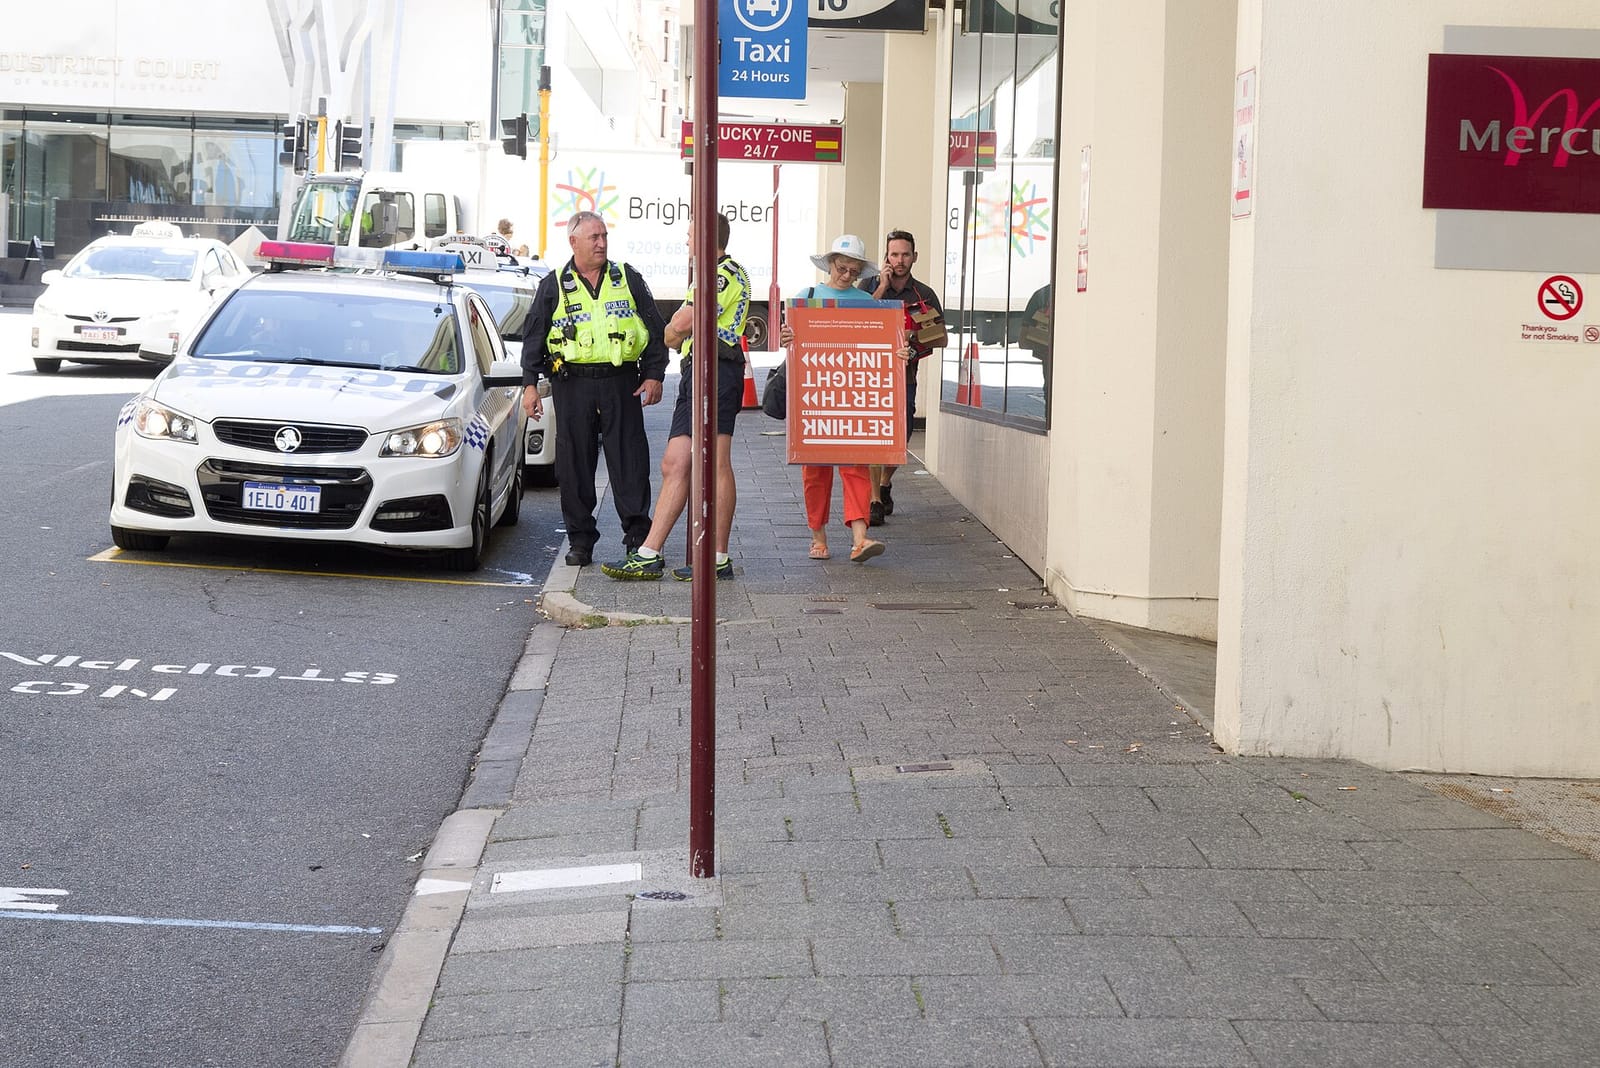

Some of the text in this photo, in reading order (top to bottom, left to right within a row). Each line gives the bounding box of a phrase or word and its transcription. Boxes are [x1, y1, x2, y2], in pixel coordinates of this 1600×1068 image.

[733, 37, 790, 63] Taxi
[0, 53, 222, 80] DISTRICT COURT
[731, 70, 790, 83] 24 Hours
[717, 127, 812, 143] UCKY 7-ONE
[743, 144, 779, 158] 24/7
[605, 300, 629, 310] POLICE
[1521, 324, 1558, 333] Thankyou
[1547, 333, 1579, 343] Smoking
[846, 352, 893, 369] LINK
[802, 371, 894, 389] FREIGHT
[821, 391, 894, 408] PERTH
[802, 419, 894, 437] RETHINK
[10, 680, 178, 701] NO
